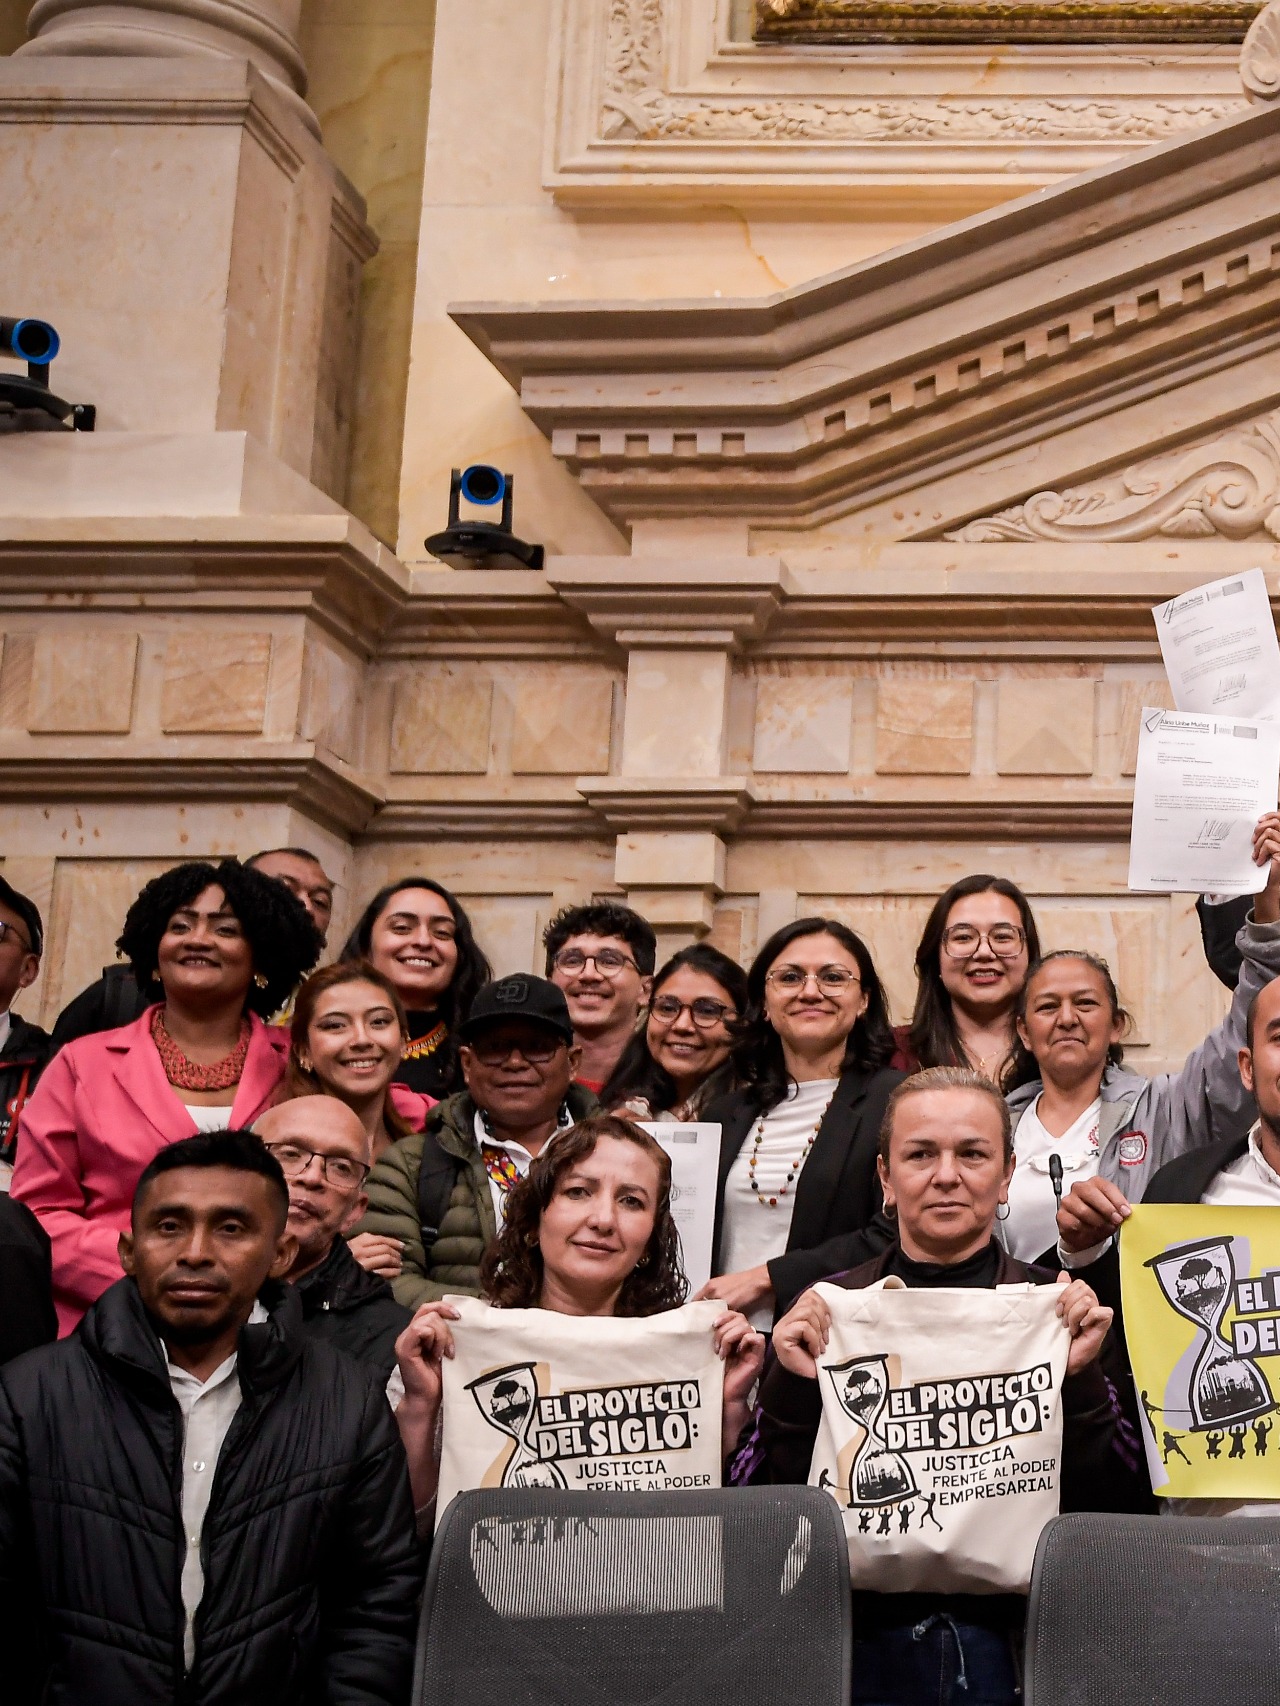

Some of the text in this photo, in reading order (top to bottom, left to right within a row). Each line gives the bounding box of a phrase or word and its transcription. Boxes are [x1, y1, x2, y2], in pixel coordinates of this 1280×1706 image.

[1238, 1281, 1270, 1312] EL
[541, 1381, 700, 1424] EL PROYECTO
[891, 1366, 1052, 1416] EL PROYECTO
[537, 1413, 699, 1459] DEL SIGLO:
[887, 1397, 1051, 1450] DEL SIGLO:
[575, 1459, 667, 1479] JUSTICIA
[922, 1444, 1016, 1472] JUSTICIA
[932, 1457, 1057, 1488] FRENTE AL PODER
[647, 1480, 661, 1491] AL
[664, 1474, 711, 1489] PODER
[940, 1476, 1054, 1506] EMPRESARIAL
